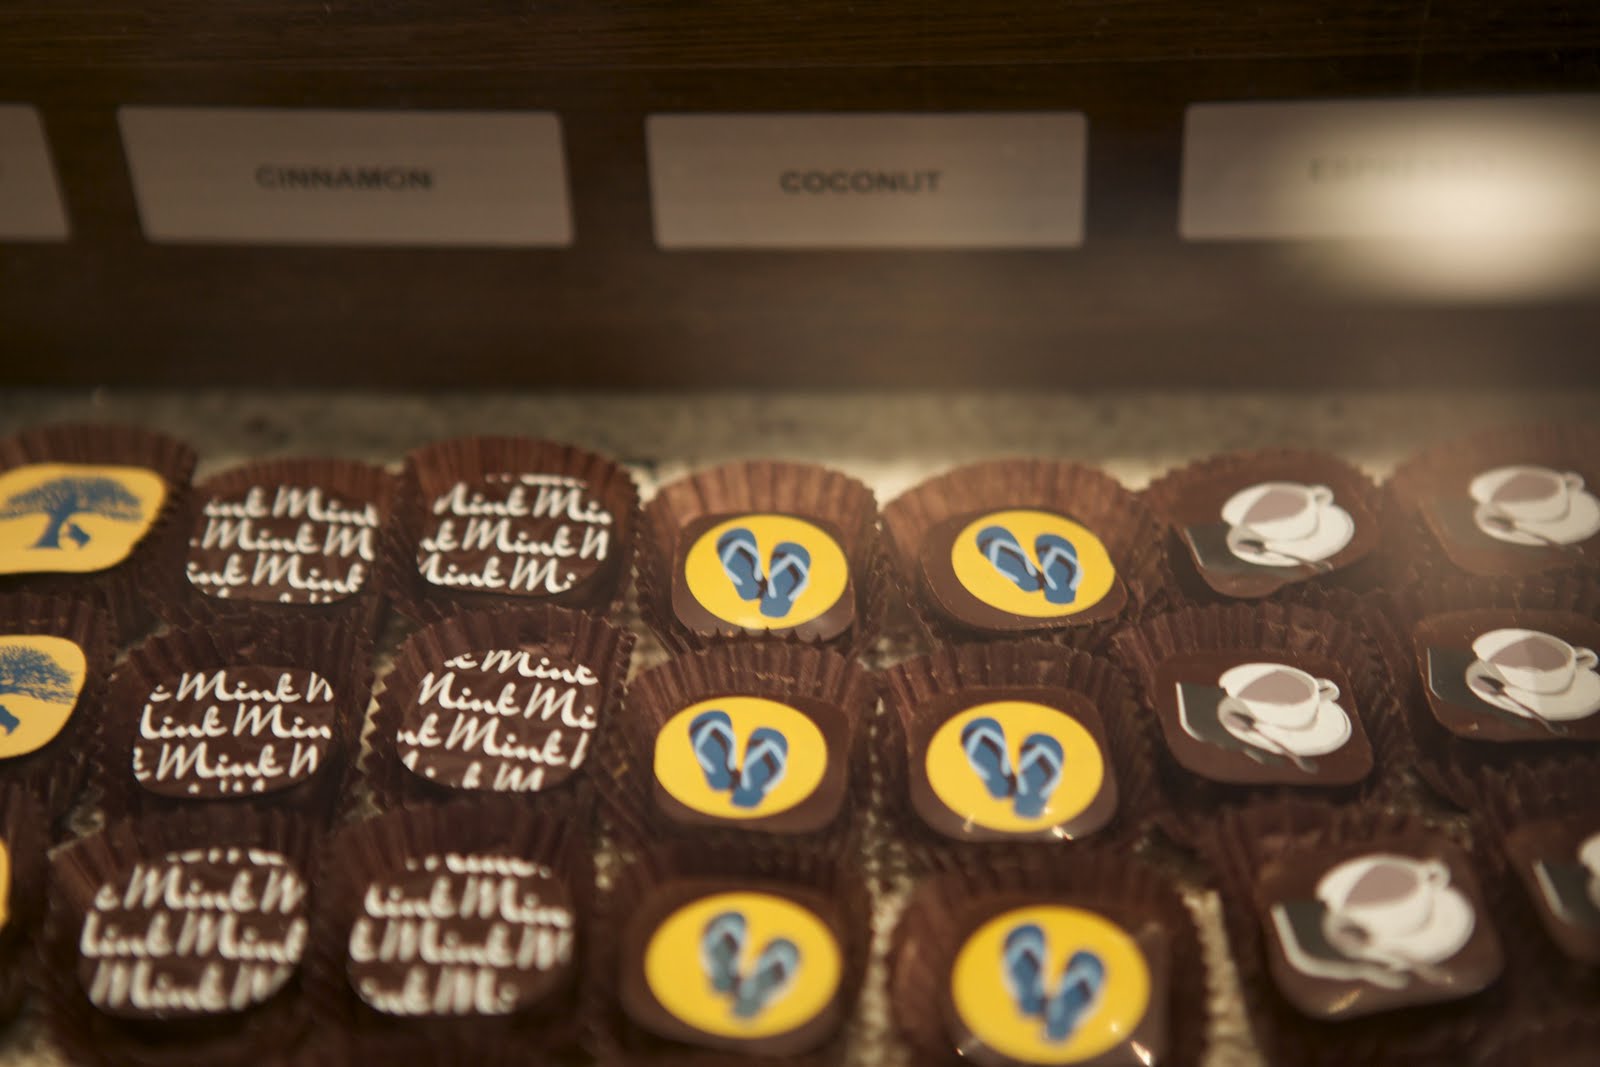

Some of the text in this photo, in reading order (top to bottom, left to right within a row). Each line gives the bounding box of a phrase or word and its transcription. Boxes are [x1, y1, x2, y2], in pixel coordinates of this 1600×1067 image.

[254, 163, 437, 191] CINNAMON
[778, 168, 944, 195] COCONUT
[203, 486, 268, 518] ink
[186, 553, 247, 586] ink
[233, 703, 332, 739] Min
[459, 874, 572, 929] Min
